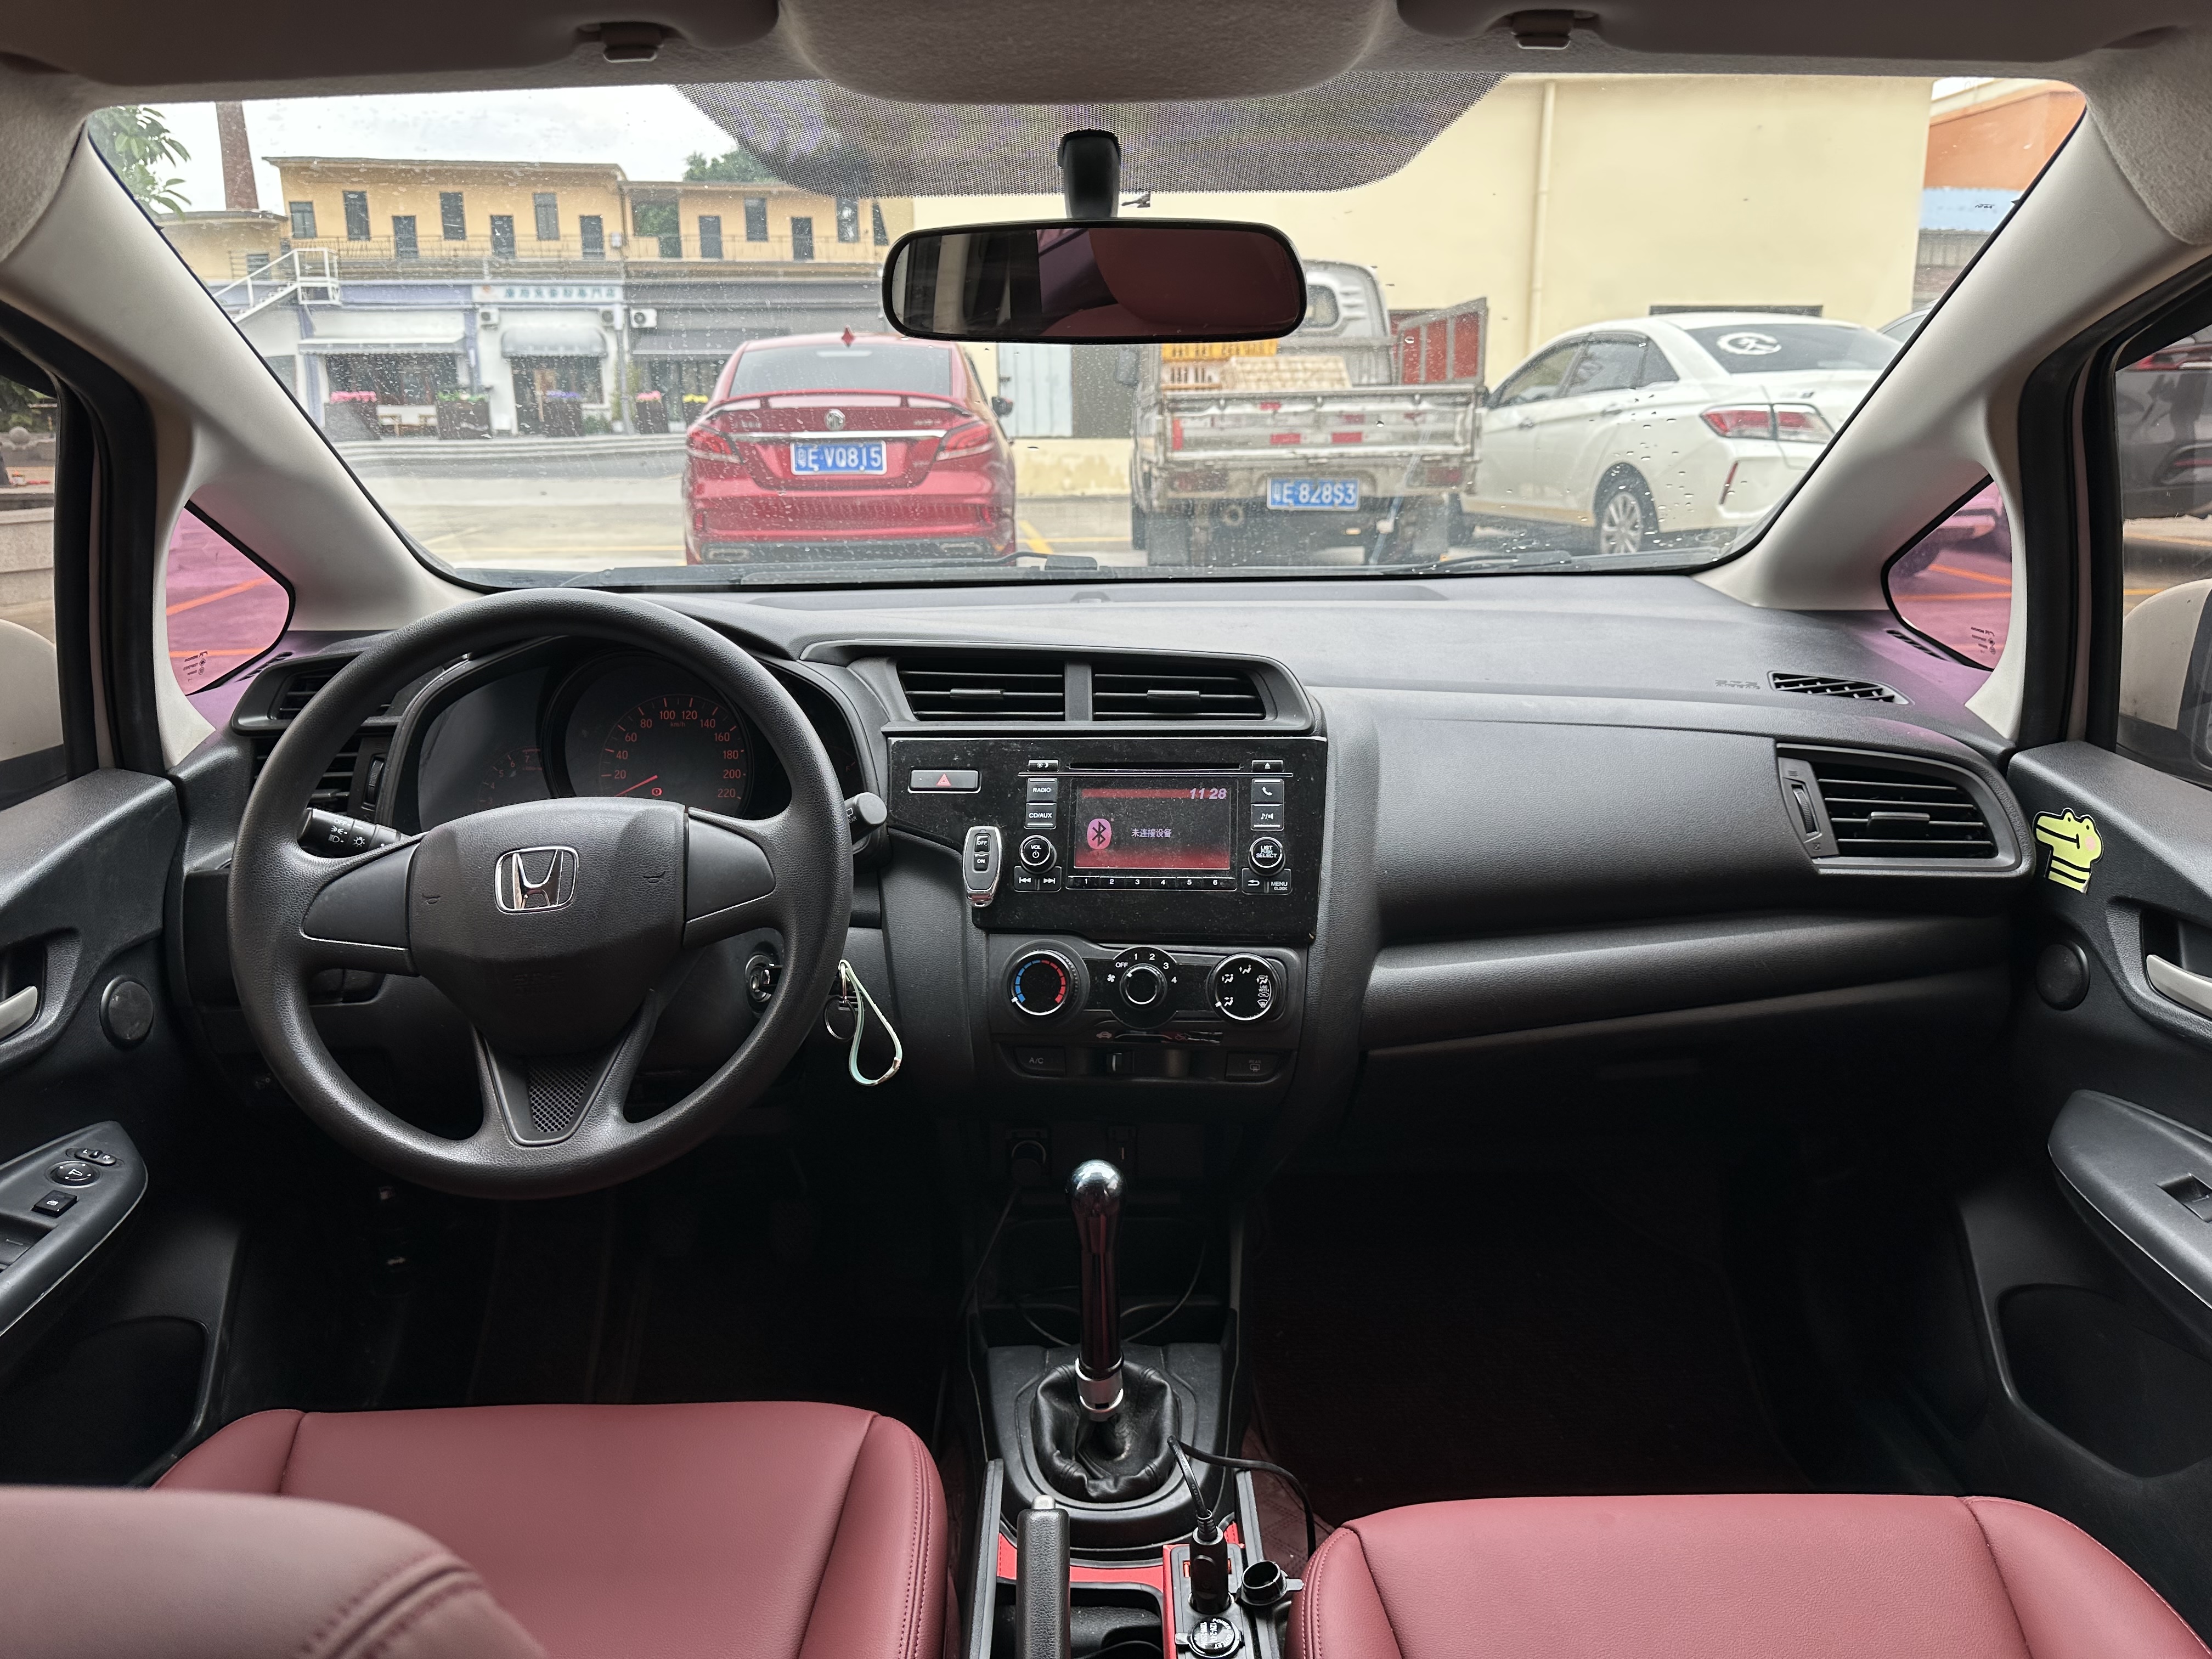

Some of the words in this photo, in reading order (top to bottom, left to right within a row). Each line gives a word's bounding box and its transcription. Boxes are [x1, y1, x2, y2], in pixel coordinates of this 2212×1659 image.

[659, 710, 675, 720] 100
[682, 710, 698, 720] 120
[640, 719, 652, 729] 80
[700, 719, 716, 728] 140
[625, 732, 637, 742] 60
[714, 732, 730, 742] 160
[616, 751, 628, 760] 40
[723, 750, 739, 759] 180
[614, 770, 626, 779] 20
[723, 769, 741, 778] 200
[717, 788, 736, 798] 220
[334, 818, 348, 826] OFF
[1131, 828, 1172, 838] 未连接设备
[1212, 1618, 1232, 1630] POWER
[1214, 1634, 1233, 1649] OUTLET
